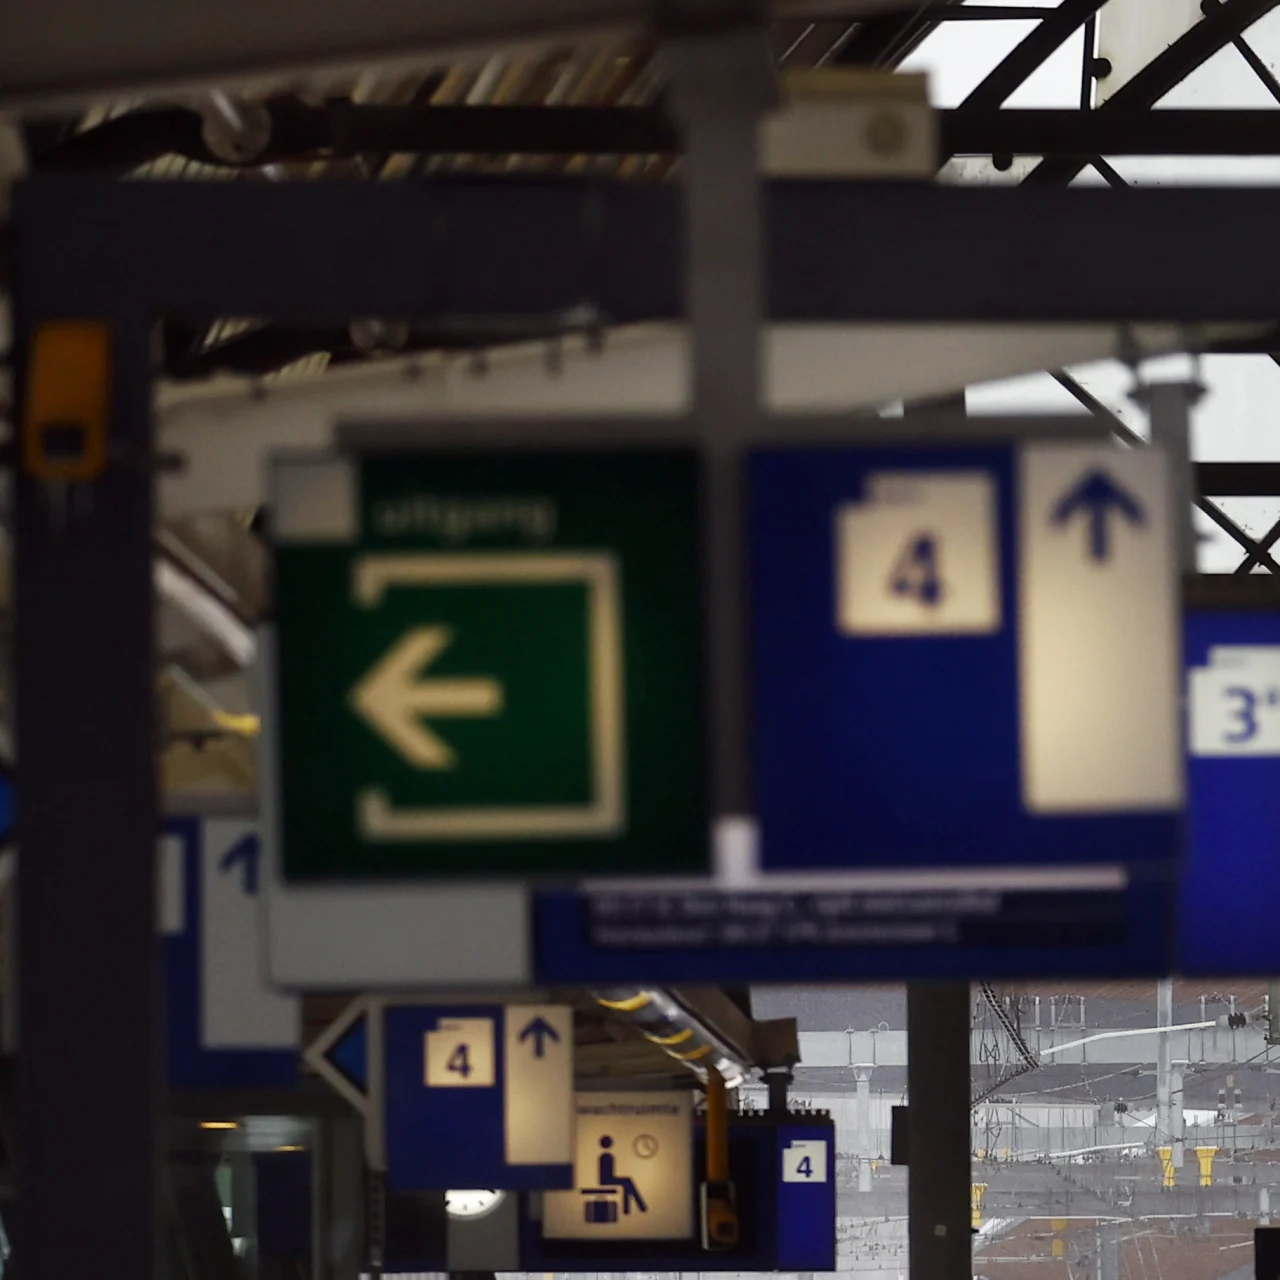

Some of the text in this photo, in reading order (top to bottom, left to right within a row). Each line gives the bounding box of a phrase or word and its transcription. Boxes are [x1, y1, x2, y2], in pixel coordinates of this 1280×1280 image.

[887, 529, 944, 608] 4
[446, 1043, 472, 1080] 4
[796, 1155, 813, 1178] 4
